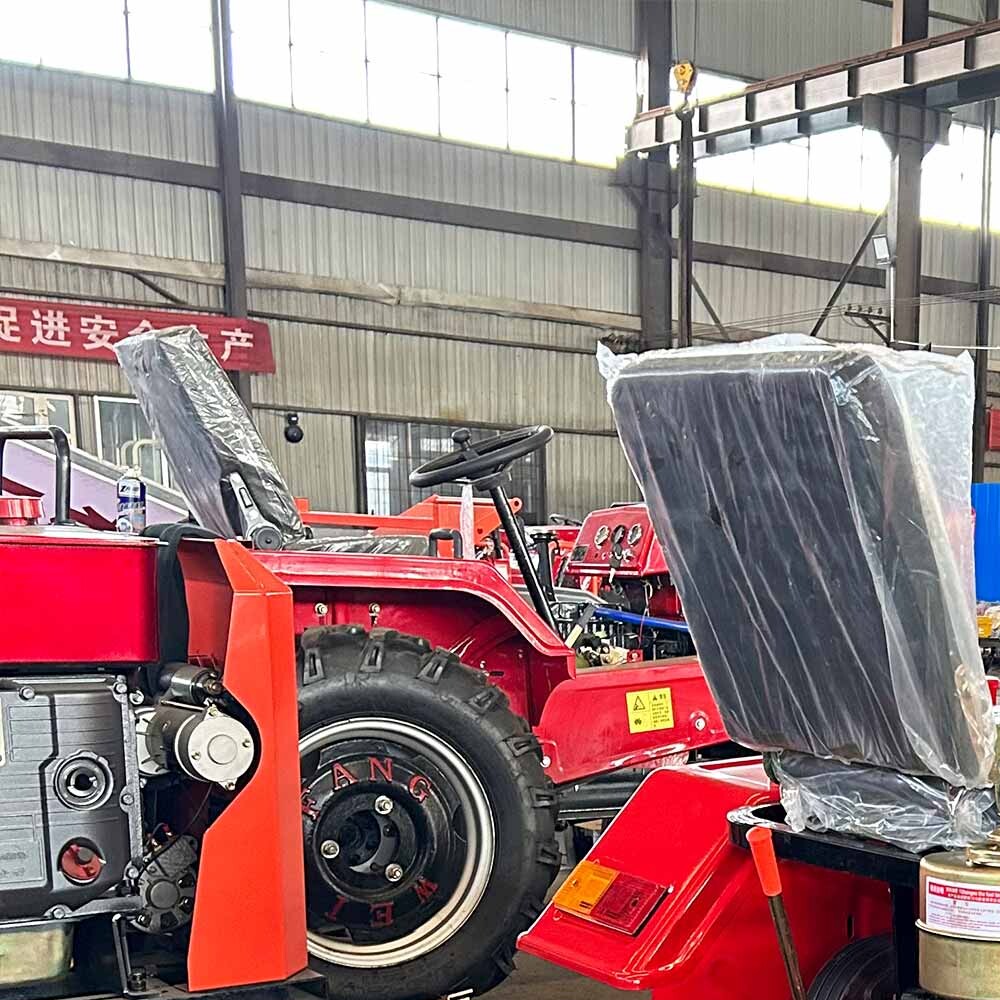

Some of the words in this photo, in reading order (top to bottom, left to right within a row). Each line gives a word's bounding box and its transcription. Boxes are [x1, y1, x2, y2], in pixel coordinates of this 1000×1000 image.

[0, 306, 254, 362] 促进安产
[300, 757, 432, 821] FANG
[324, 876, 439, 928] WEI
